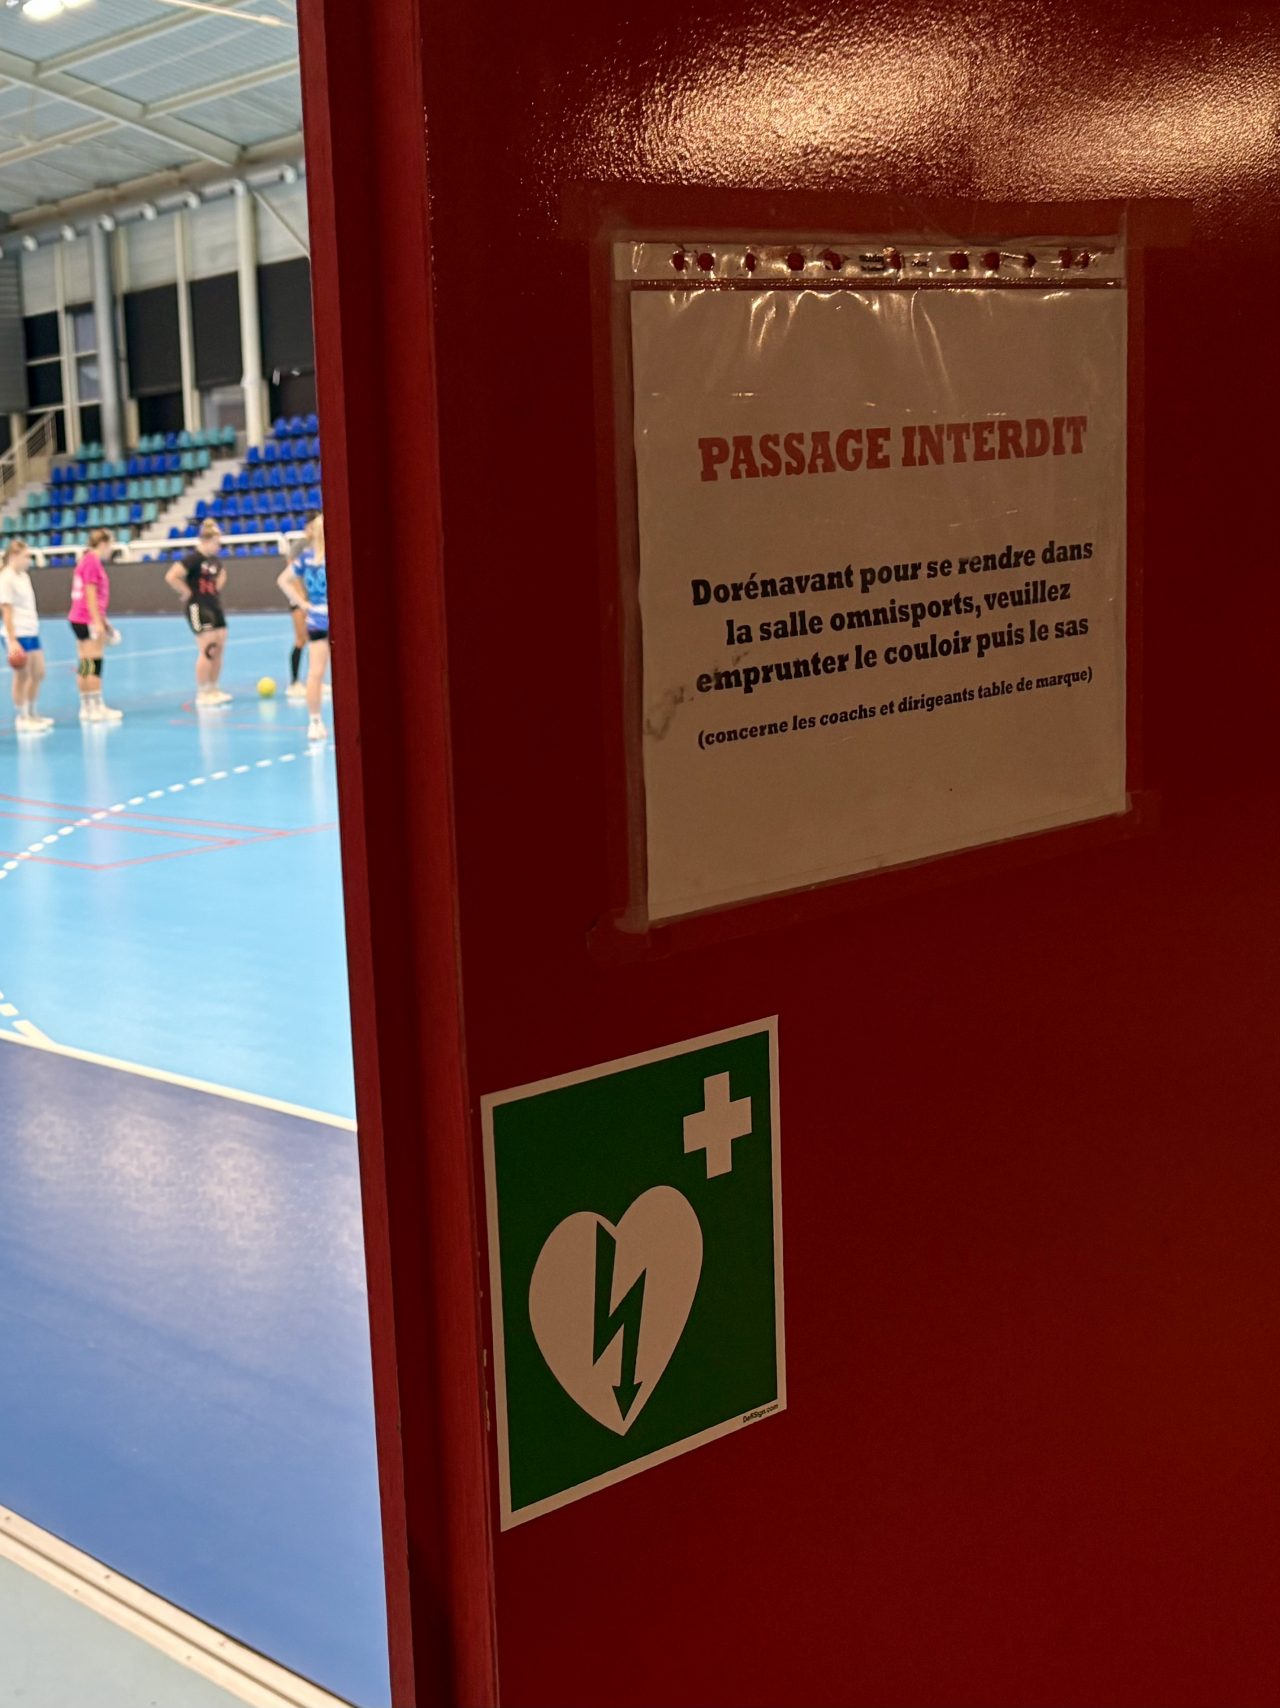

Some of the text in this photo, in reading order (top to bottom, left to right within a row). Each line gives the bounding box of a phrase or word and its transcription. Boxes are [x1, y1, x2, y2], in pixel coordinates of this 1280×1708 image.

[698, 415, 1088, 482] PASSAGE INTERDIT
[691, 540, 1093, 606] Dorénavant pour se rendre dans
[696, 617, 1089, 694] emprunter le couloir puis le sas
[726, 619, 753, 645] la
[759, 610, 823, 641] salle
[698, 666, 1093, 750] (concerne les coachs et dirigeants table de marque)
